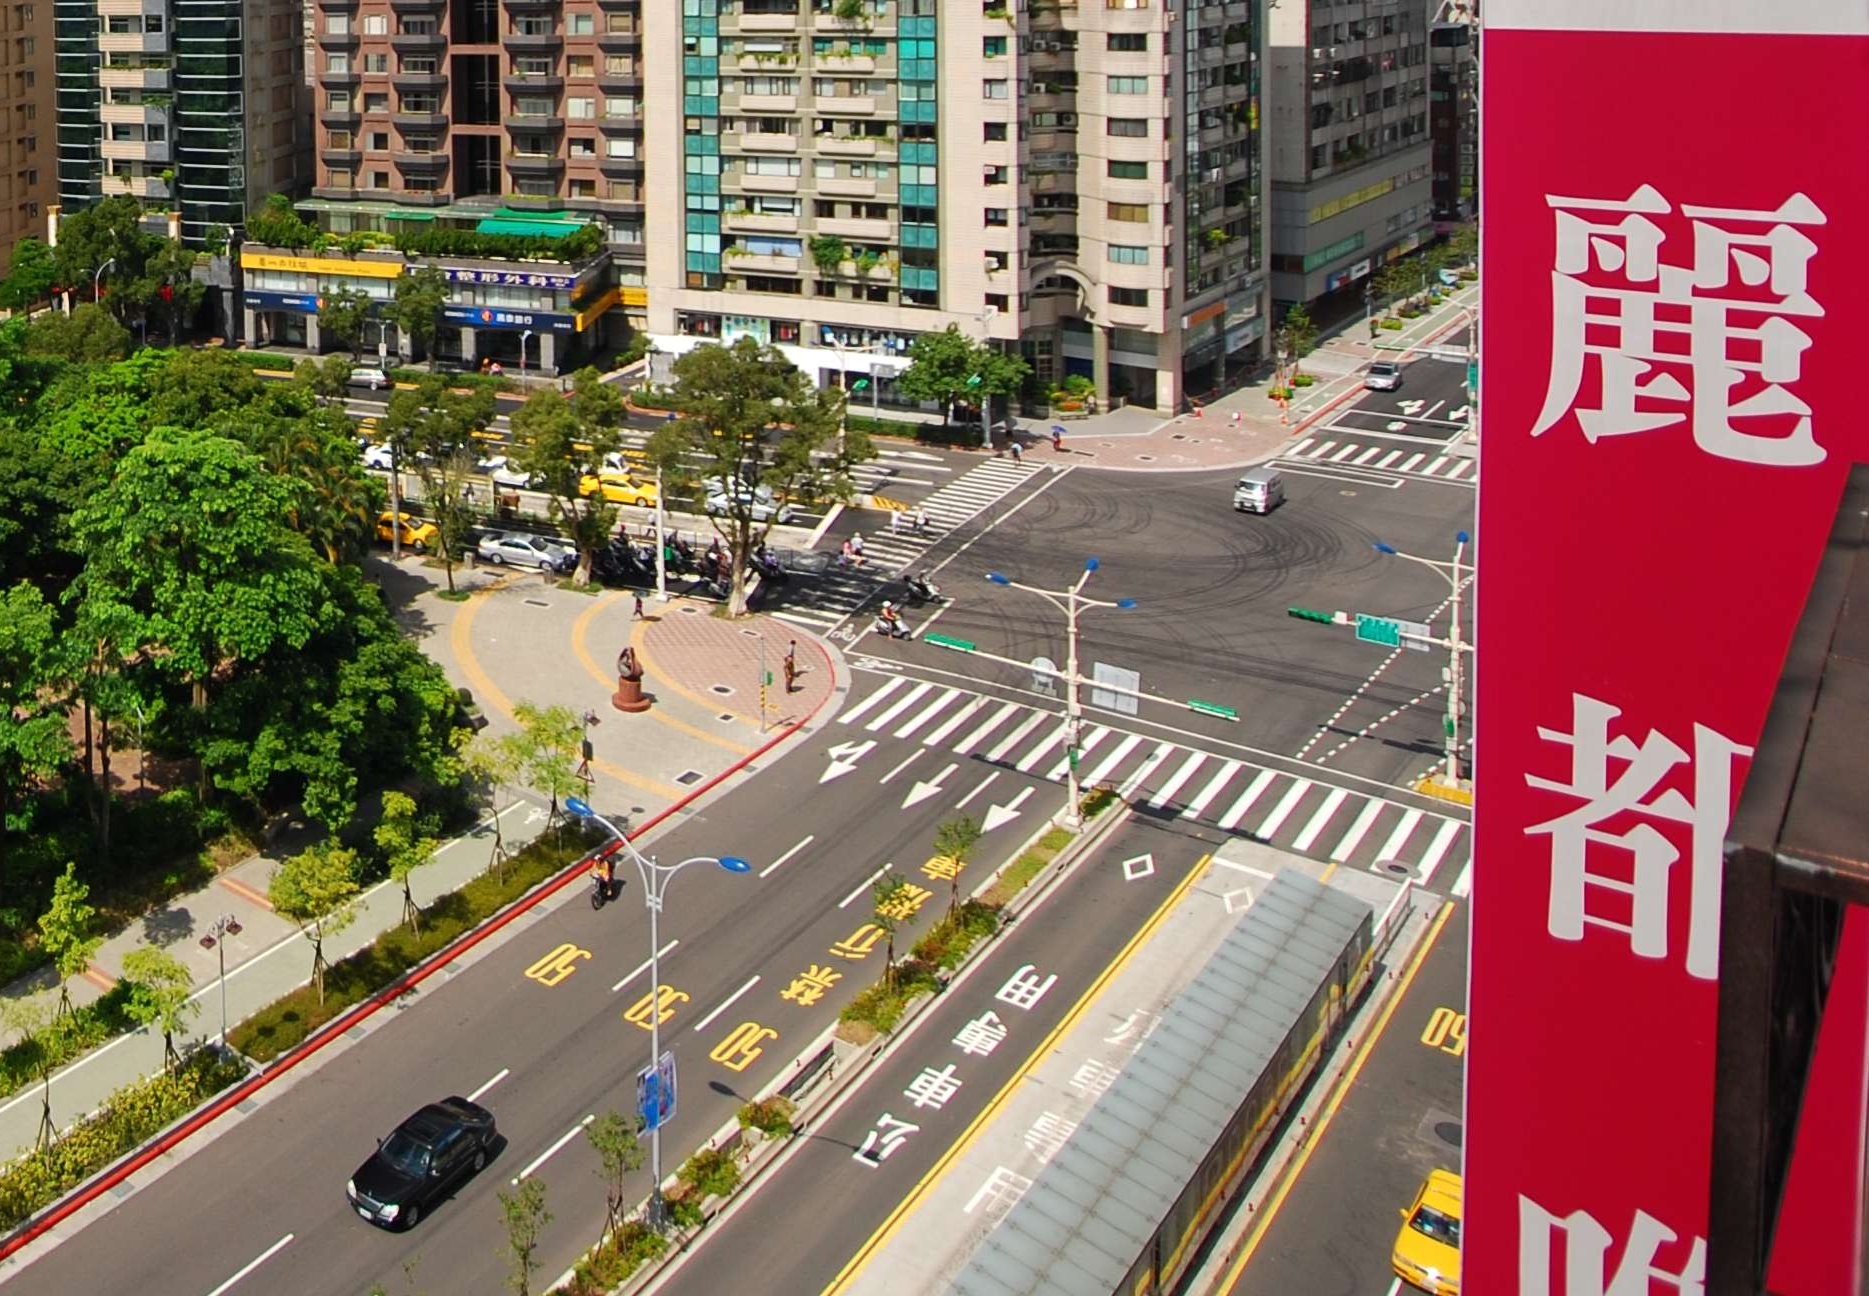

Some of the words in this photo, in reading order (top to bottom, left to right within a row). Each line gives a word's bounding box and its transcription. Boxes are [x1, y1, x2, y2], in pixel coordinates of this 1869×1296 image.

[524, 943, 592, 987] 50
[623, 985, 690, 1031] 50
[709, 1021, 778, 1072] 50
[851, 963, 1059, 1169] 公車專用
